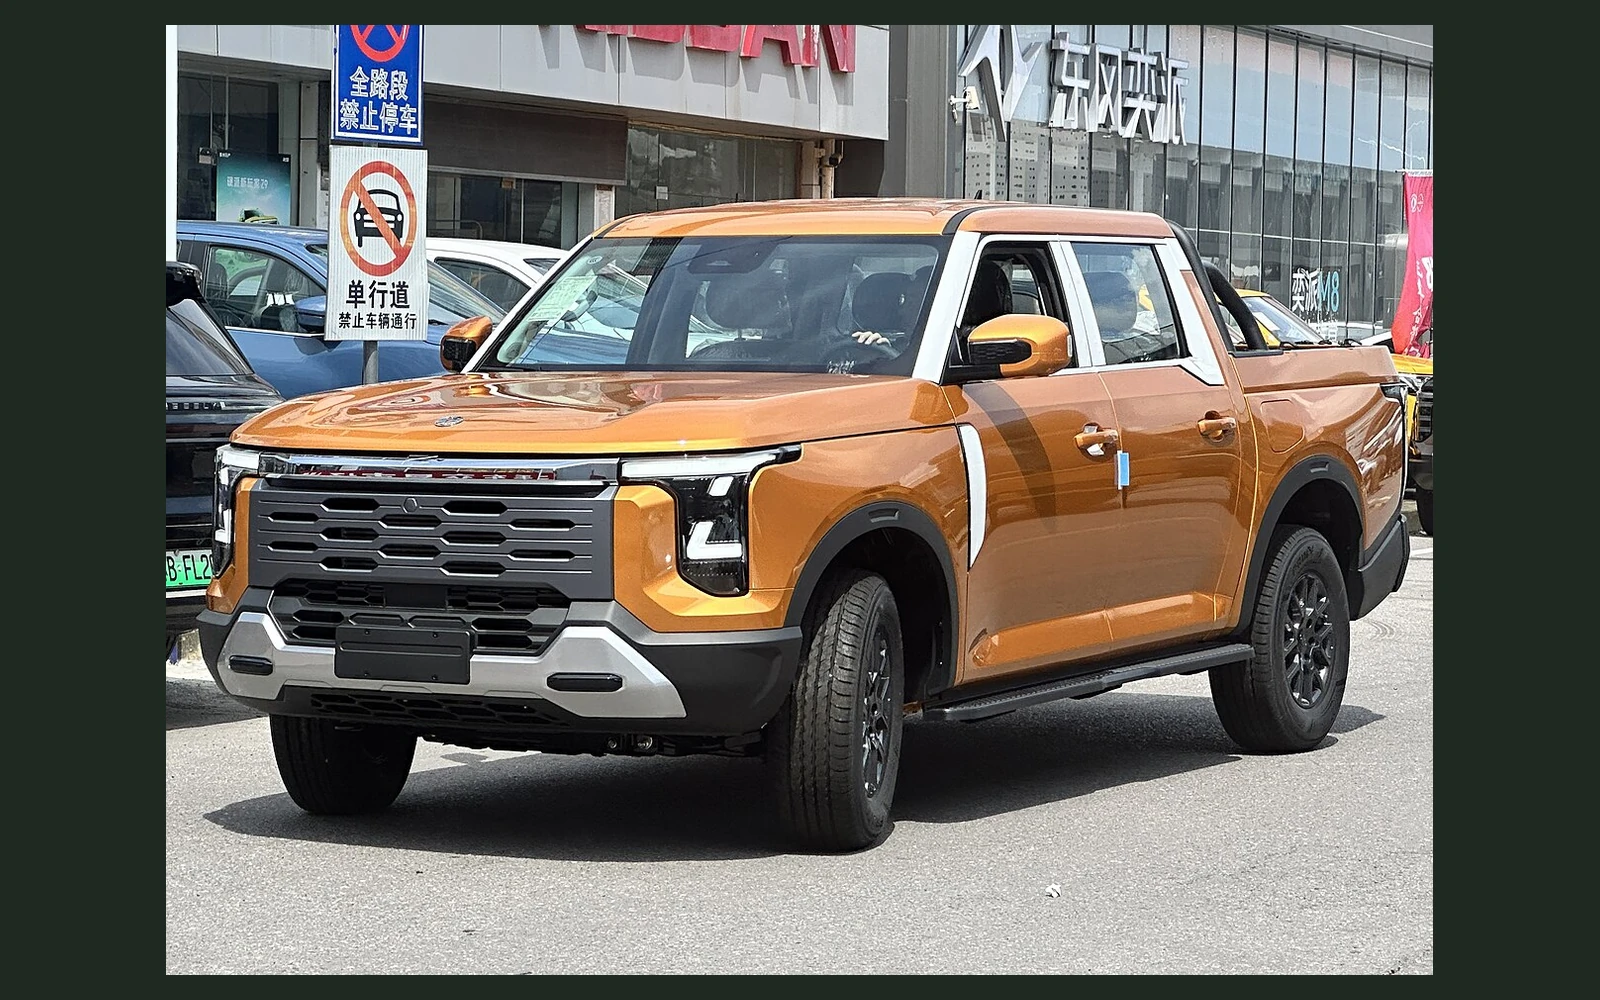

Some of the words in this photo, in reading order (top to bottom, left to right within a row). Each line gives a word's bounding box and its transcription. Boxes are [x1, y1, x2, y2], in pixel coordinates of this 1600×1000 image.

[349, 66, 409, 100] 全路段
[1051, 32, 1189, 146] 东风奕派
[340, 99, 418, 134] 禁止停车
[346, 280, 411, 309] 单行道
[338, 311, 417, 330] 禁止车辆通行
